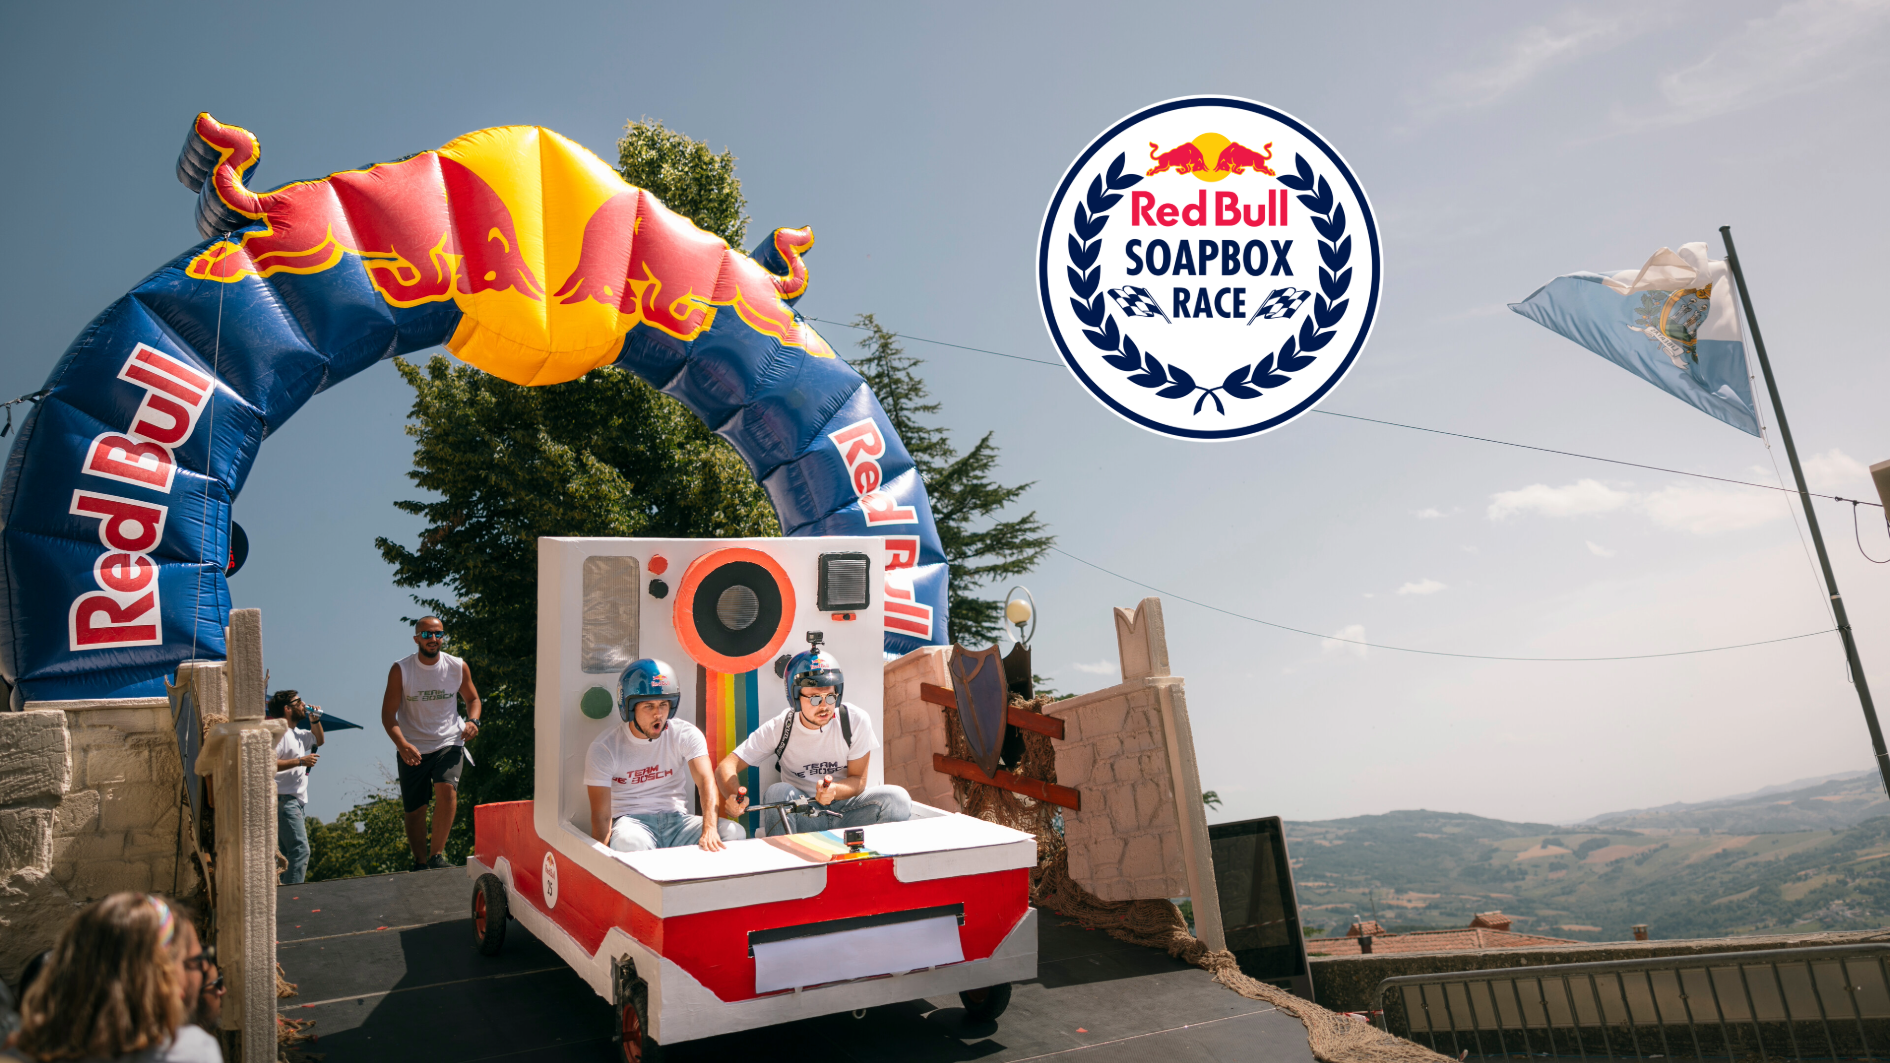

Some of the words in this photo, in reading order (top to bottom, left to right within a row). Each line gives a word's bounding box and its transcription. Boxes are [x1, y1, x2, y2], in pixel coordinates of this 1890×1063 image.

[84, 344, 214, 491] Bull
[830, 419, 917, 524] Red
[71, 491, 166, 649] Red
[626, 764, 659, 778] TEAM
[803, 761, 838, 771] TEAM
[631, 768, 673, 785] BOSCH
[547, 879, 553, 896] 25
